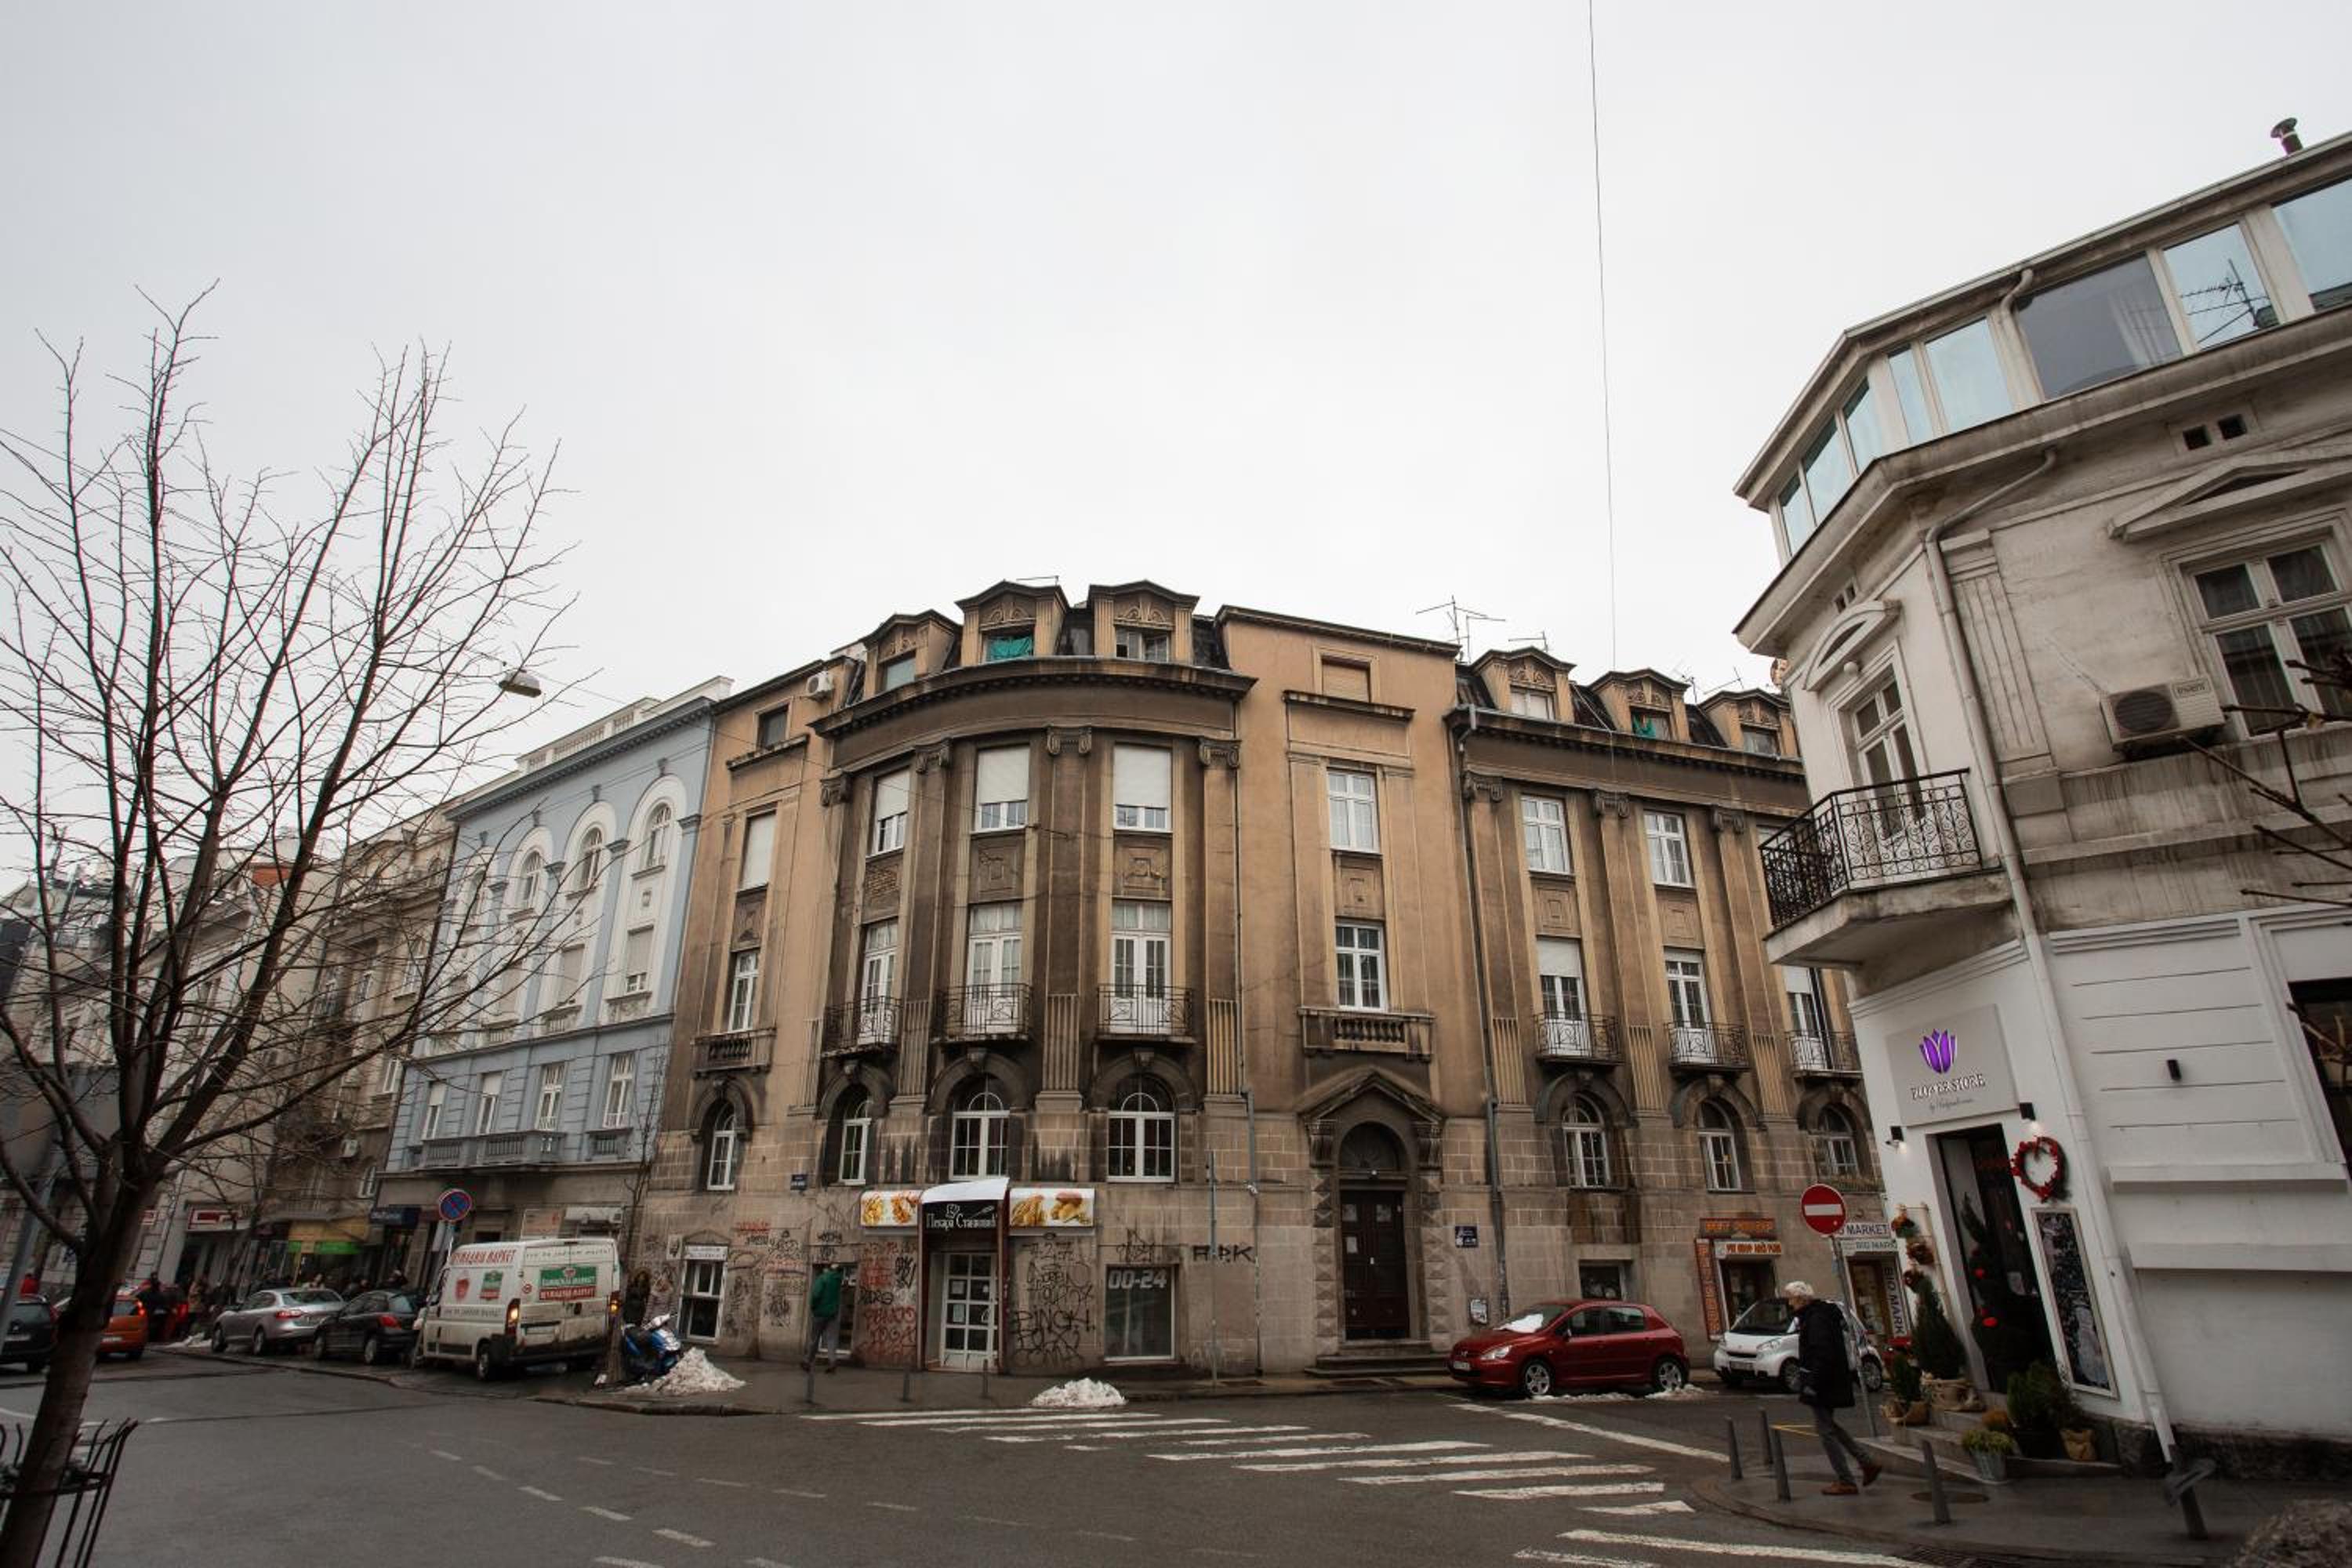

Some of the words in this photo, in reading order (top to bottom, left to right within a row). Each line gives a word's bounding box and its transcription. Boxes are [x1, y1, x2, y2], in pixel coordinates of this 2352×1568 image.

[1951, 1073, 1986, 1091] STORE
[1846, 1224, 1889, 1235] MARKET
[1108, 1269, 1167, 1289] 00-24
[1884, 1267, 1895, 1291] BIO
